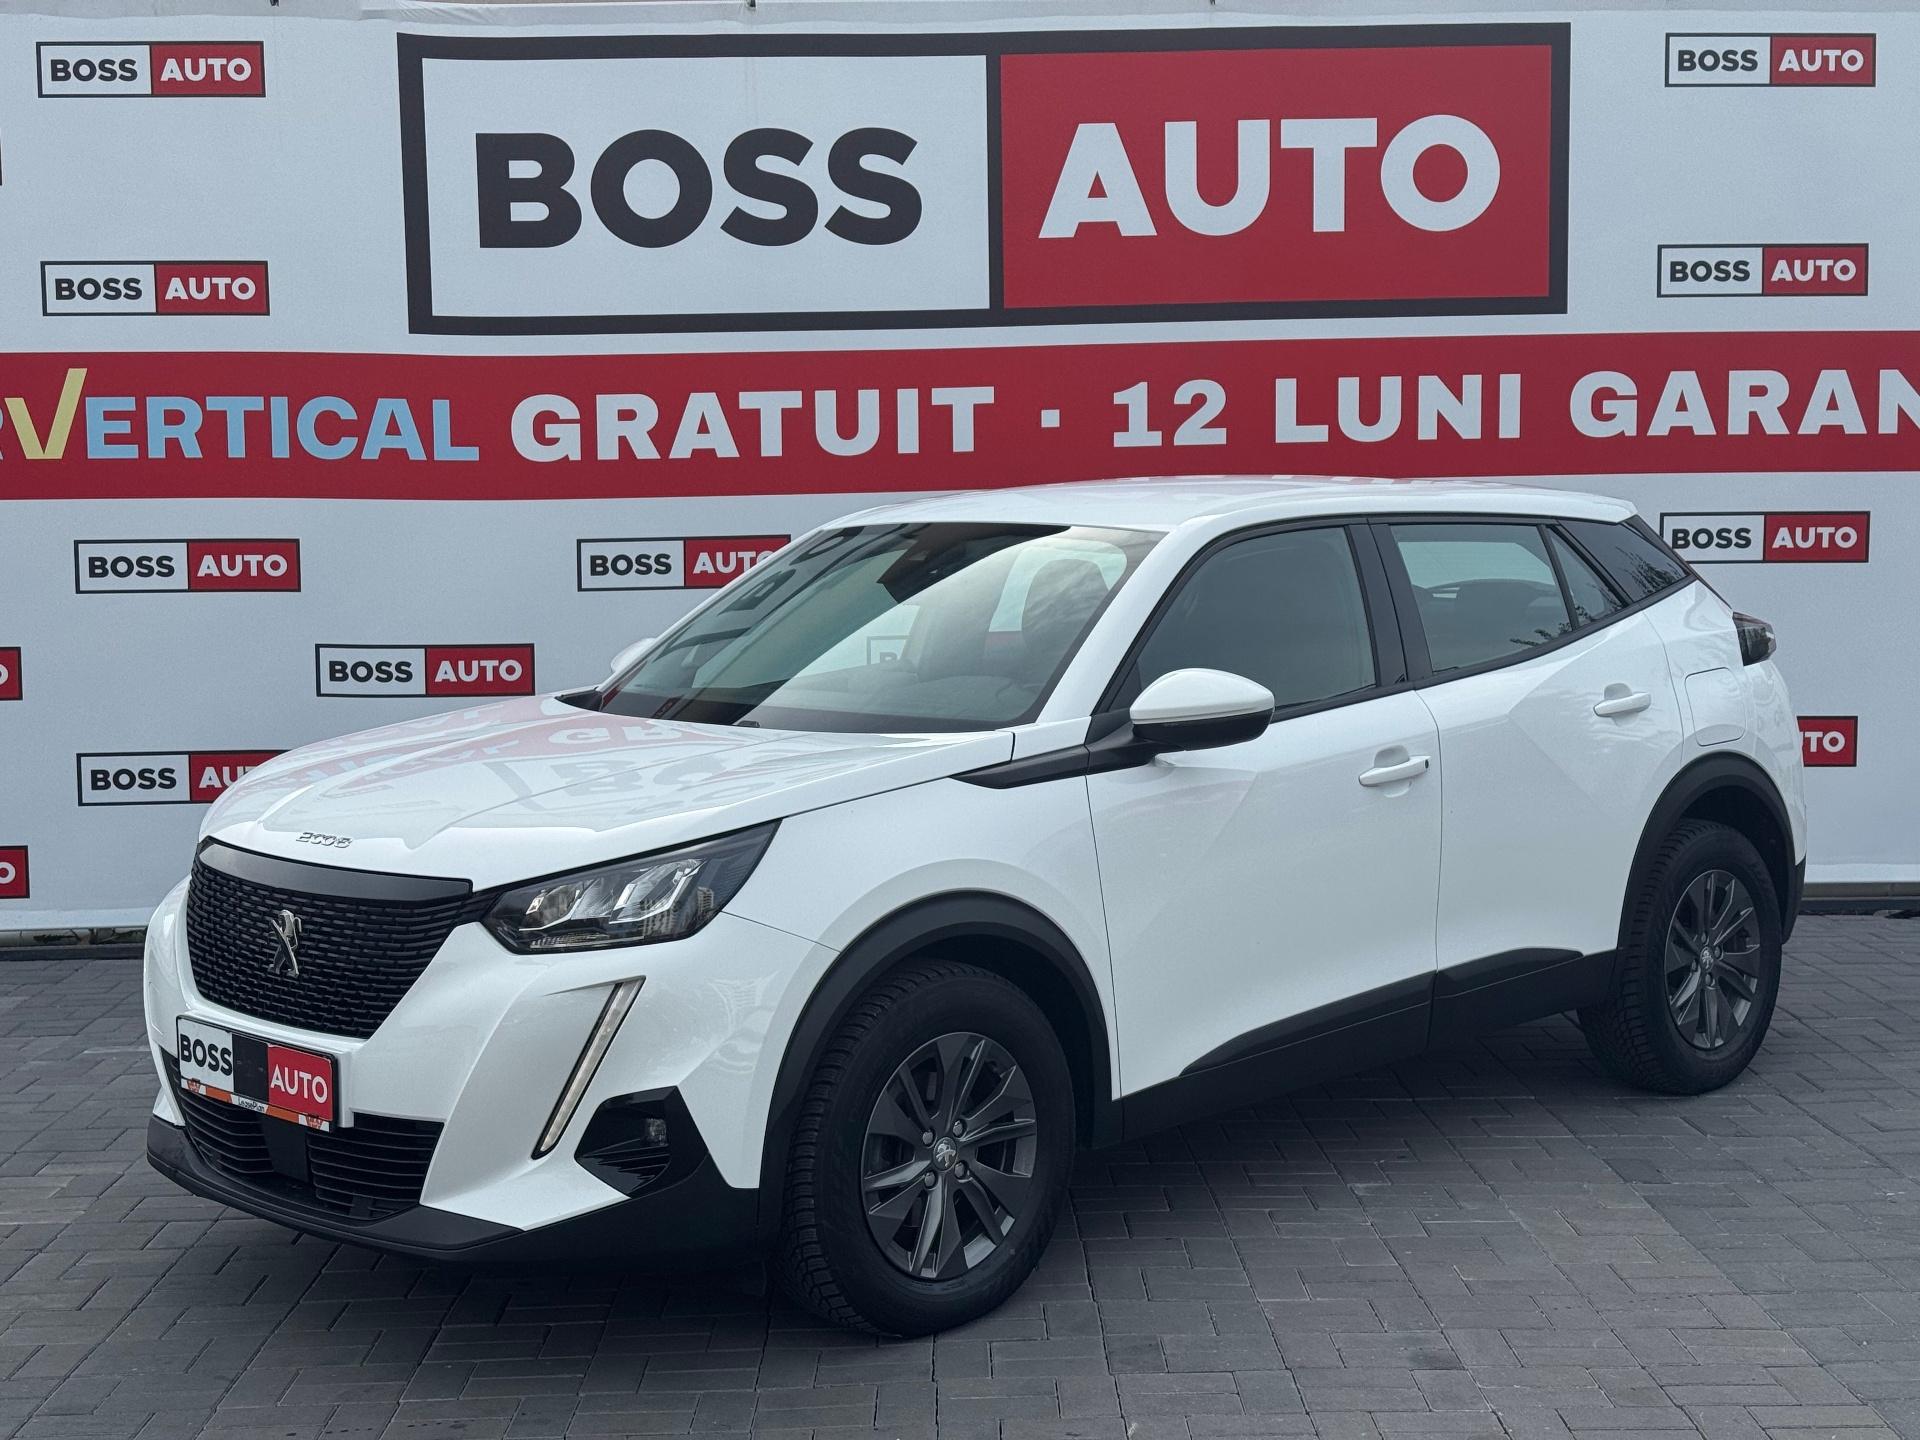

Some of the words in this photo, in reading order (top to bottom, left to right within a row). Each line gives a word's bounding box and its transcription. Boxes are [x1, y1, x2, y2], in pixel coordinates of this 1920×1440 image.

[51, 59, 137, 81] BOSS
[161, 58, 251, 81] AUTO
[1678, 50, 1758, 71] BOSS
[1779, 50, 1863, 71] AUTO
[476, 128, 922, 248] BOSS
[1039, 115, 1500, 238] AUTO
[1670, 260, 1750, 282] BOSS
[1771, 259, 1856, 281] AUTO
[55, 278, 142, 300] BOSS
[165, 277, 255, 299] AUTO
[0, 368, 479, 461] VERTICAL
[511, 387, 994, 462] GRATUIT
[1114, 380, 1226, 447] 12
[1276, 374, 1521, 443] LUNI
[1672, 528, 1751, 549] BOSS
[1772, 527, 1857, 548] AUTO
[89, 556, 174, 578] BOSS
[197, 555, 287, 576] AUTO
[590, 554, 671, 576] BOSS
[329, 661, 413, 682] BOSS
[435, 660, 522, 682] AUTO
[1799, 731, 1845, 752] TO
[91, 768, 176, 790] BOSS
[199, 766, 258, 788] AU
[296, 831, 352, 848] 2008
[181, 1034, 233, 1076] BOSS
[271, 1064, 328, 1104] AUTO
